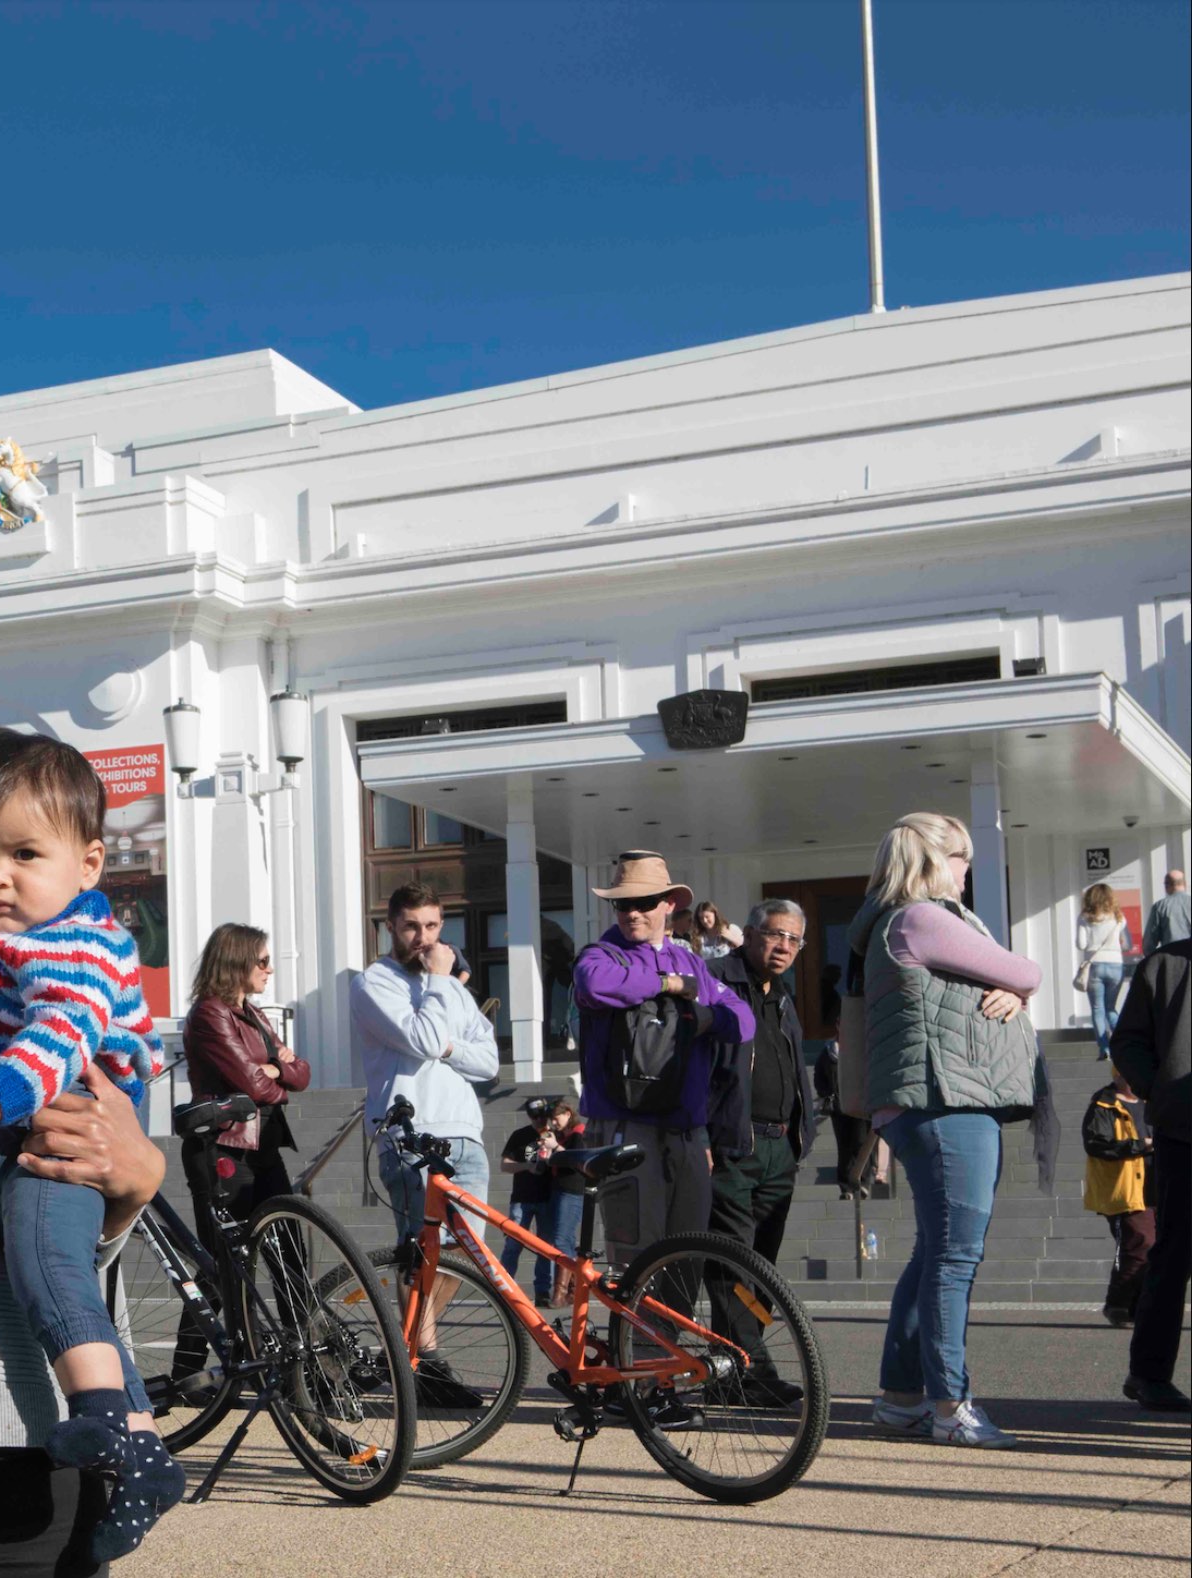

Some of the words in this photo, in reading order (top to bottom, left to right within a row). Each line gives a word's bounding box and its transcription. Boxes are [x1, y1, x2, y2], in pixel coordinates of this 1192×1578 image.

[97, 767, 156, 781] XHIBITIONS
[111, 781, 147, 794] TOURS
[1089, 857, 1108, 869] AD
[456, 1229, 514, 1293] GIANT
